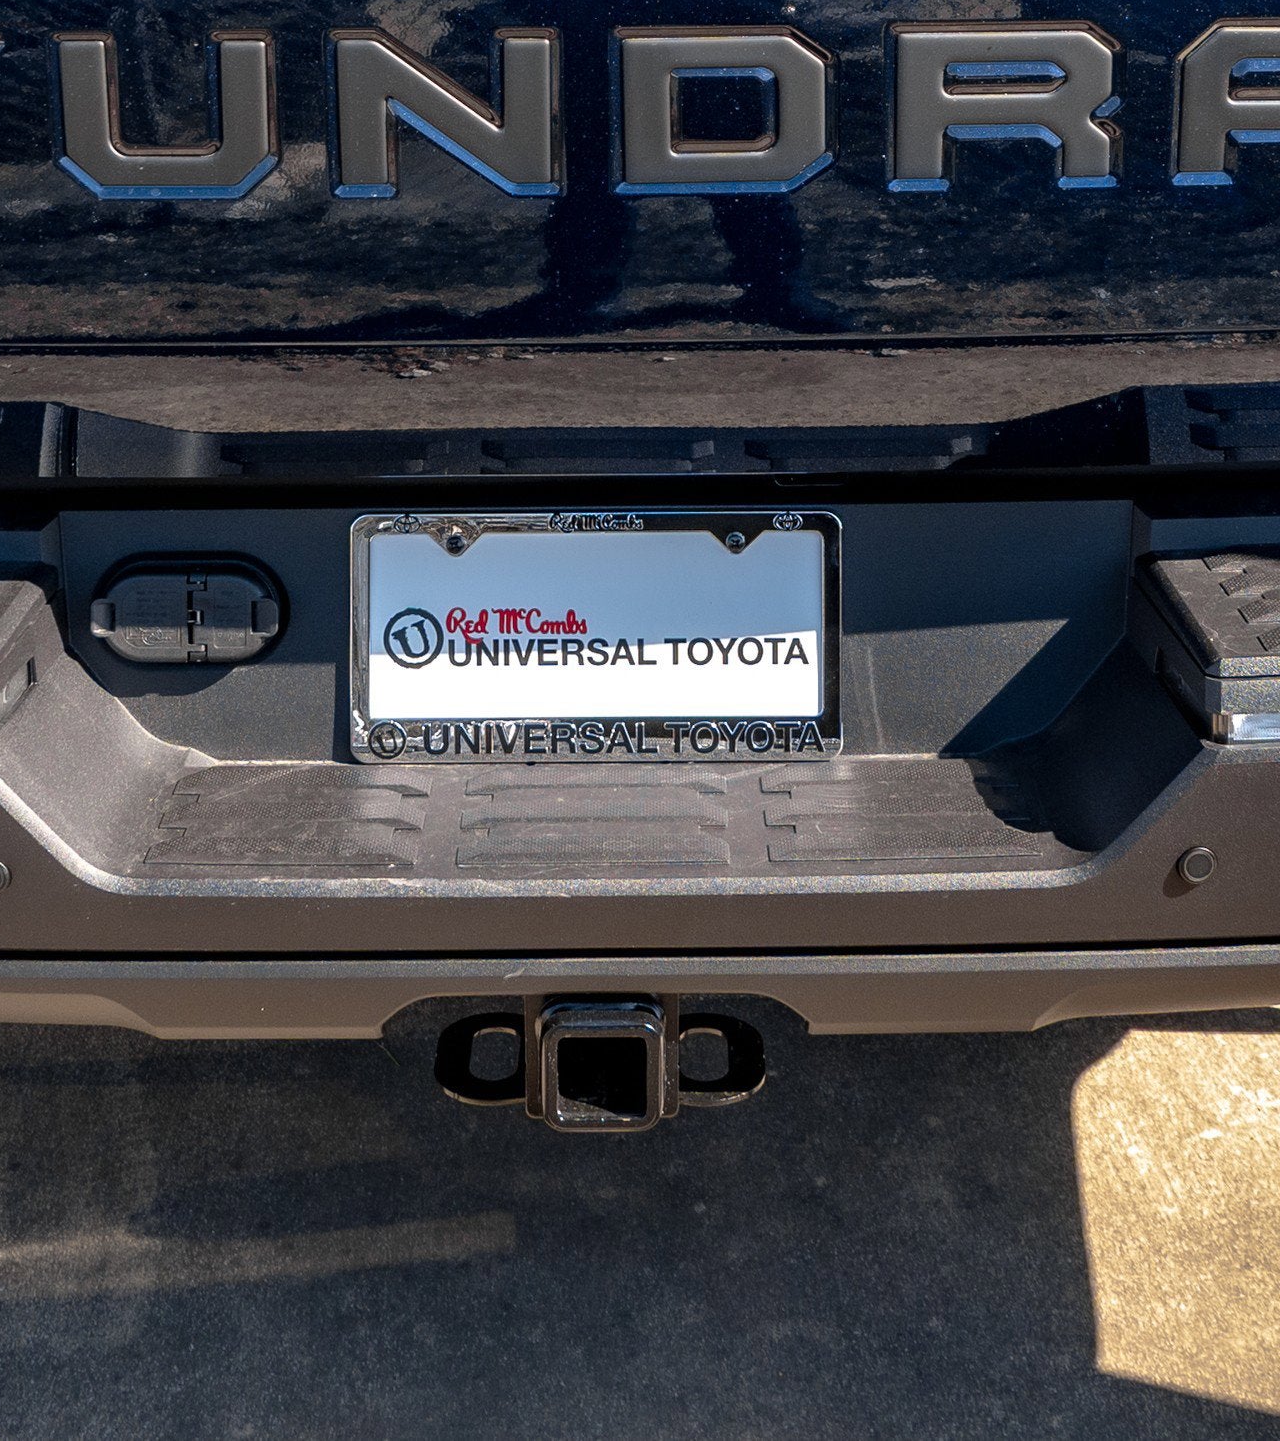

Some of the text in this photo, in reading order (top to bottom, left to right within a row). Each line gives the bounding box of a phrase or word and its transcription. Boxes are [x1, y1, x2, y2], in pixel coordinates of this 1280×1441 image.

[445, 606, 588, 645] Red McCombs
[448, 637, 810, 667] UNIVERSAL TOYOTA
[422, 719, 827, 755] UNIVERSAL TOYOTA
